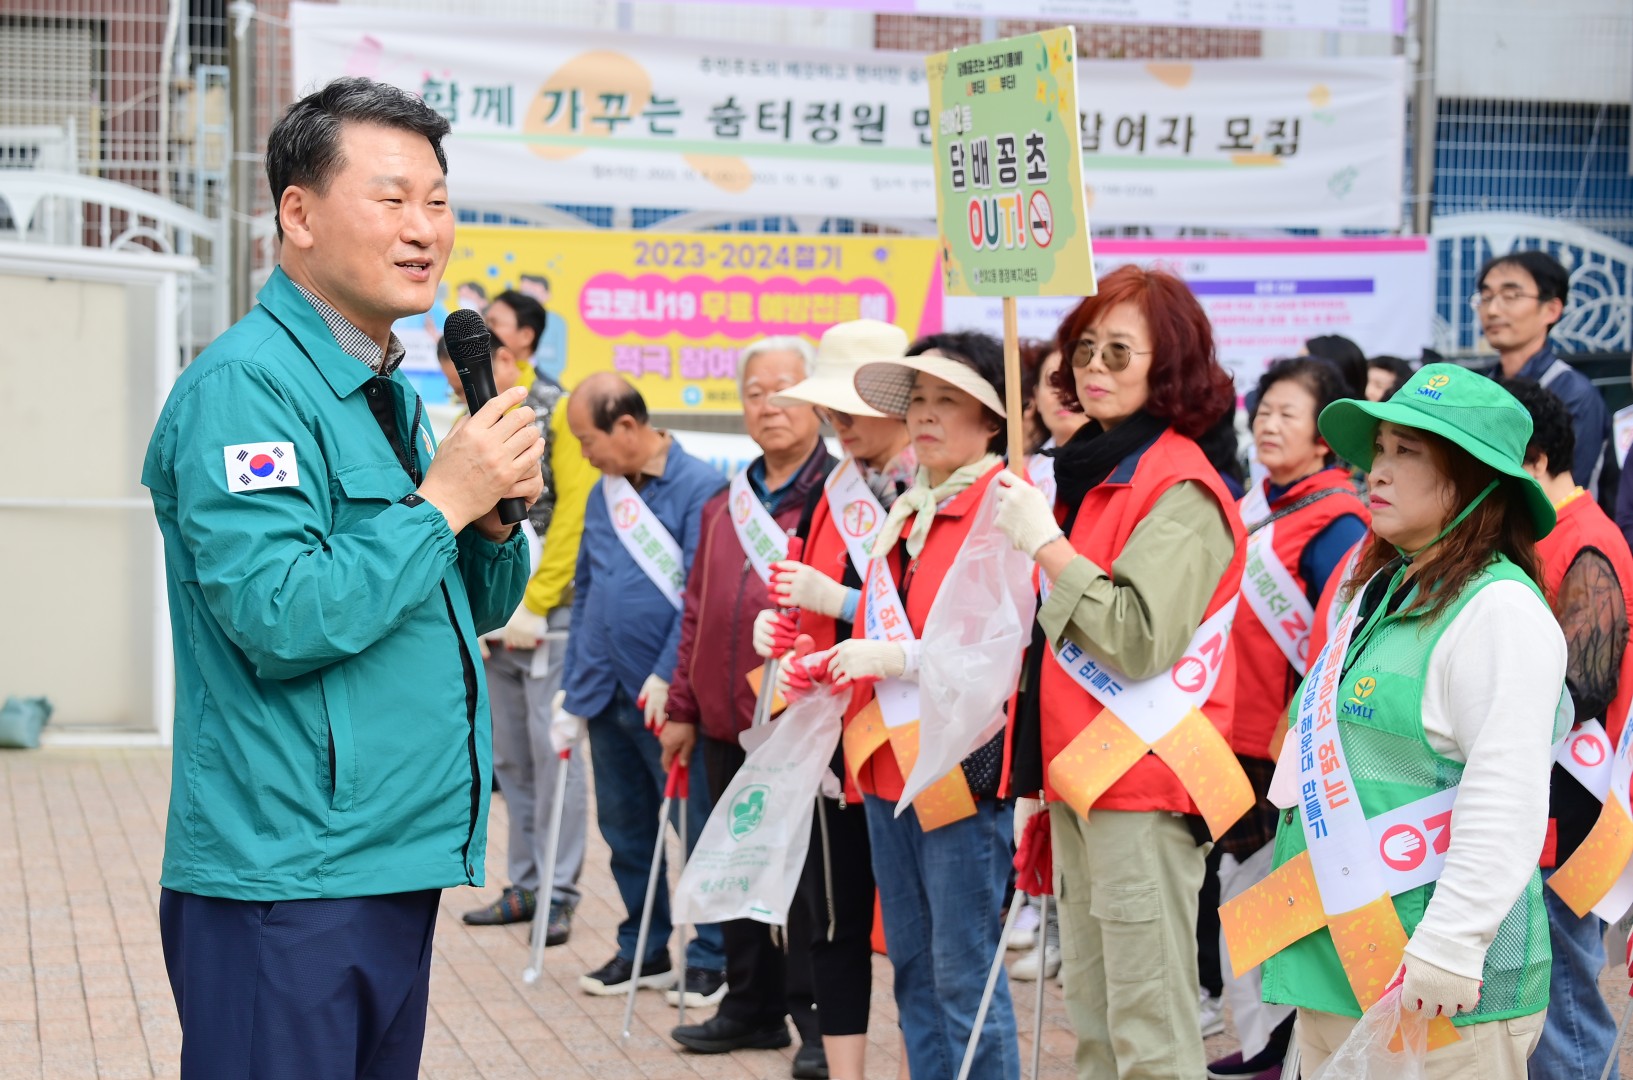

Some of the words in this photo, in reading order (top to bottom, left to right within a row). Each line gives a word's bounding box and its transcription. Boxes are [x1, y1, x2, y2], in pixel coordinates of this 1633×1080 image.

[422, 79, 513, 127] 함께
[542, 87, 682, 135] 가꾸는
[706, 97, 886, 144] 숨터정원
[1217, 115, 1300, 156] 모집
[950, 133, 1048, 189] 담배꽁초
[968, 193, 1026, 248] OUT!
[633, 240, 843, 270] 2023-2024절기
[584, 288, 696, 321] 코로나19
[1415, 387, 1443, 401] SMU
[1078, 661, 1124, 698] 만들기
[1340, 700, 1375, 720] SMU
[1300, 712, 1315, 773] 해운대
[1317, 738, 1350, 811] 없는
[1301, 779, 1329, 840] 만들기
